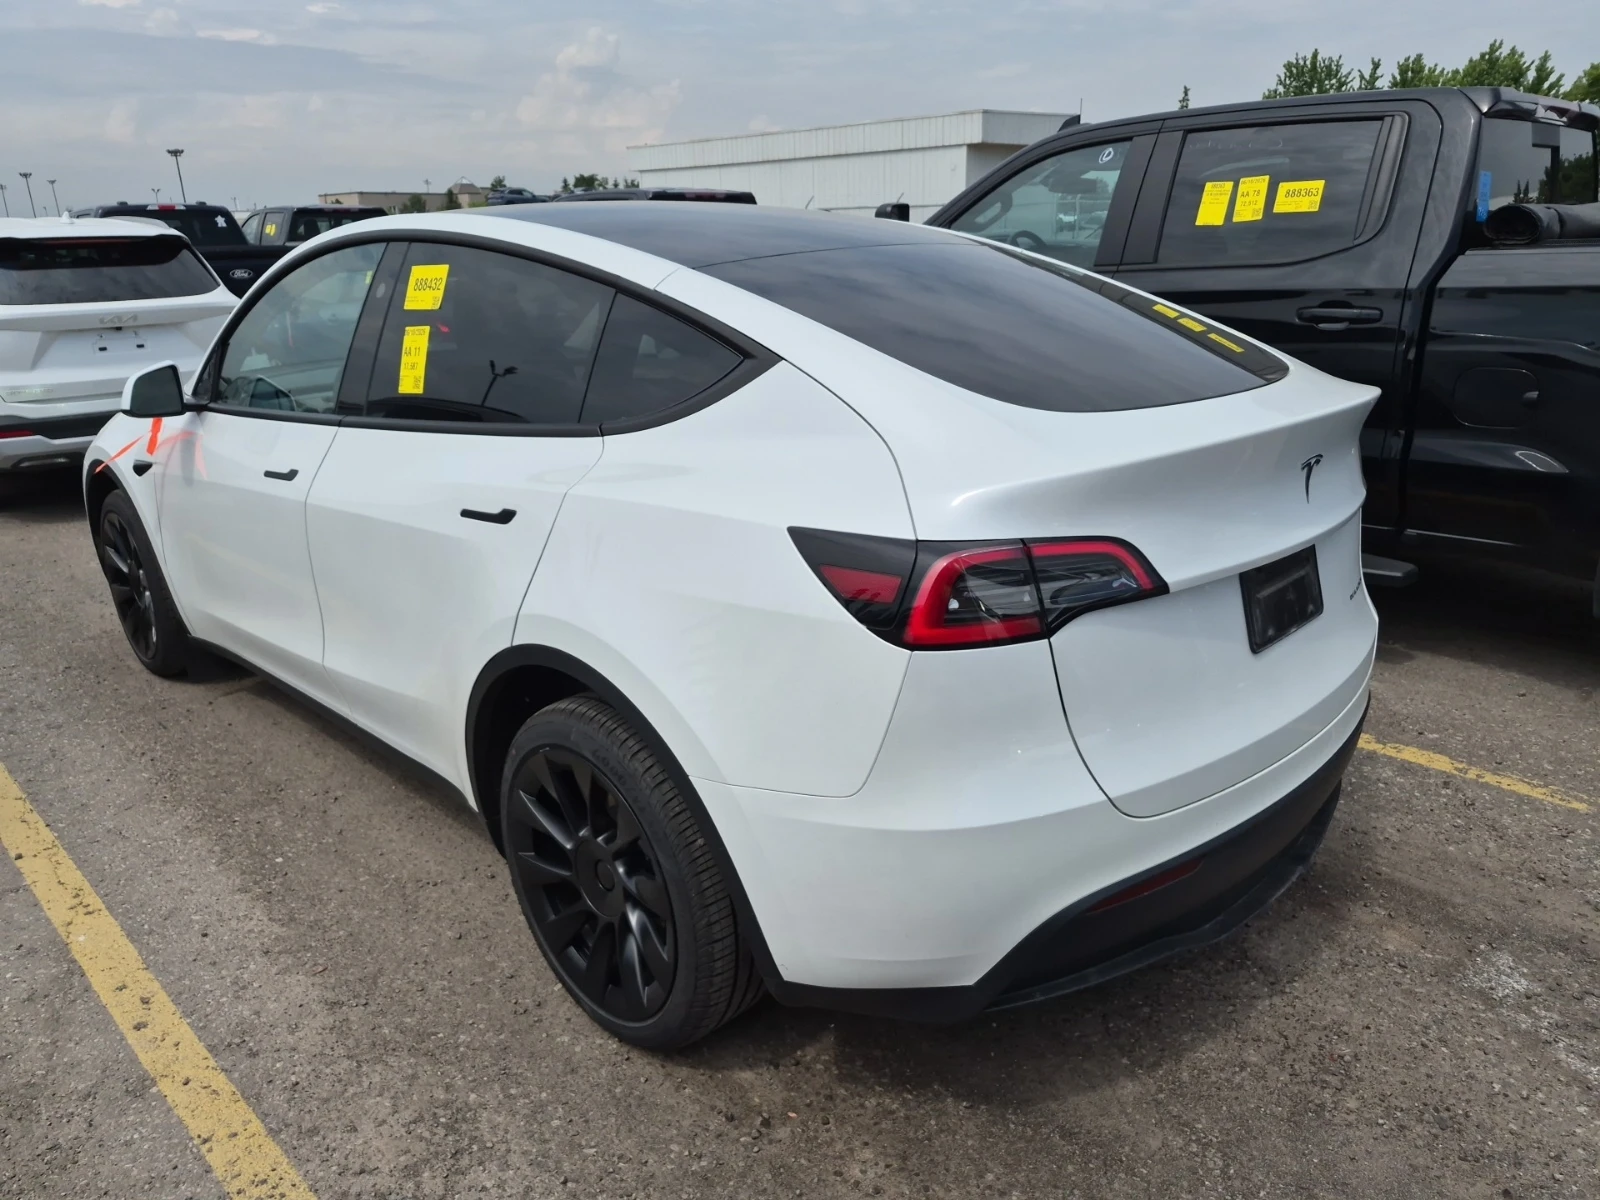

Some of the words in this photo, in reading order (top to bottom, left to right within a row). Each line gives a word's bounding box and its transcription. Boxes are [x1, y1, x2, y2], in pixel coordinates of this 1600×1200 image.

[1240, 191, 1250, 199] AA
[1252, 189, 1261, 197] 78
[1284, 187, 1319, 198] 888363
[413, 277, 442, 291] 888432
[404, 346, 412, 357] AA
[414, 346, 421, 357] 11
